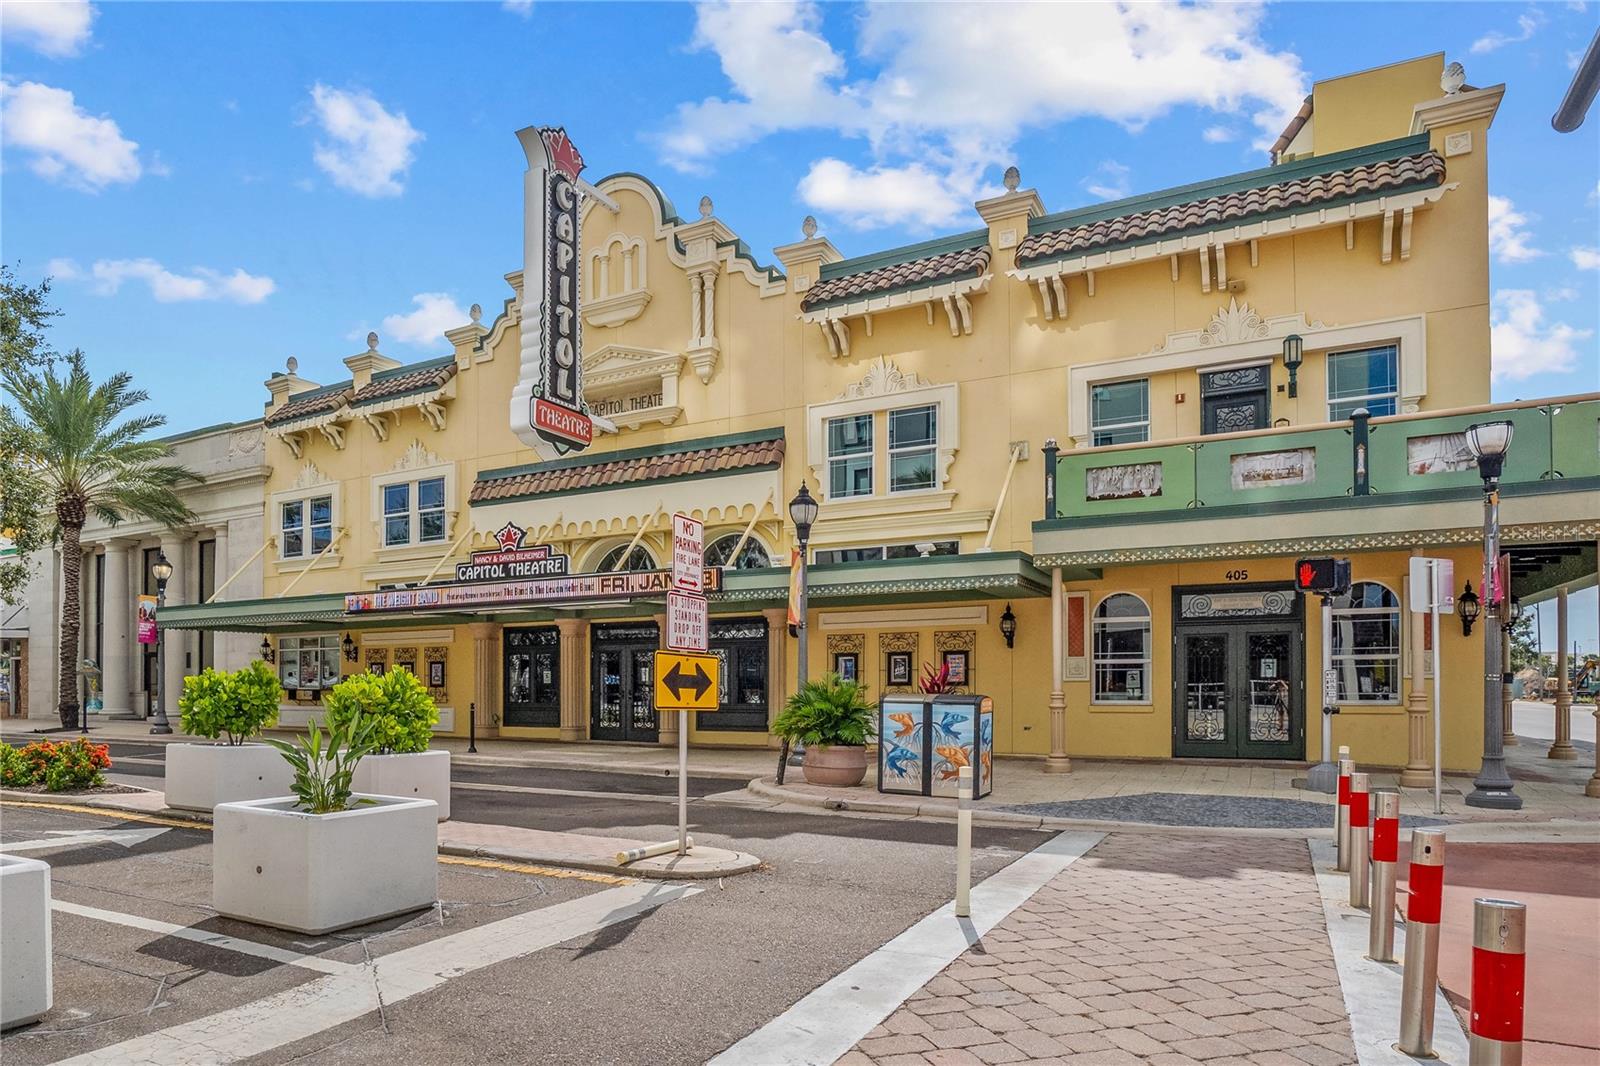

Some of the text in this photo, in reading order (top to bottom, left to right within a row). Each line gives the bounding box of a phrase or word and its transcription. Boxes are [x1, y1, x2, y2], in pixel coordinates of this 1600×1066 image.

[556, 181, 574, 399] CAPITOL
[539, 405, 590, 438] THEATRE
[683, 521, 694, 536] NO
[675, 536, 701, 555] PARKING
[474, 555, 492, 565] NANCY
[493, 555, 499, 563] &
[499, 553, 515, 562] DAVID
[676, 552, 700, 567] FIRE LANE
[459, 559, 564, 580] CAPITOL THEATRE
[1225, 570, 1249, 581] 405
[418, 590, 440, 605] BAND
[670, 596, 704, 612] NO STOPPING
[675, 609, 701, 623] STANDING
[674, 622, 702, 636] DROP OFF
[675, 636, 701, 648] ANY TIME
